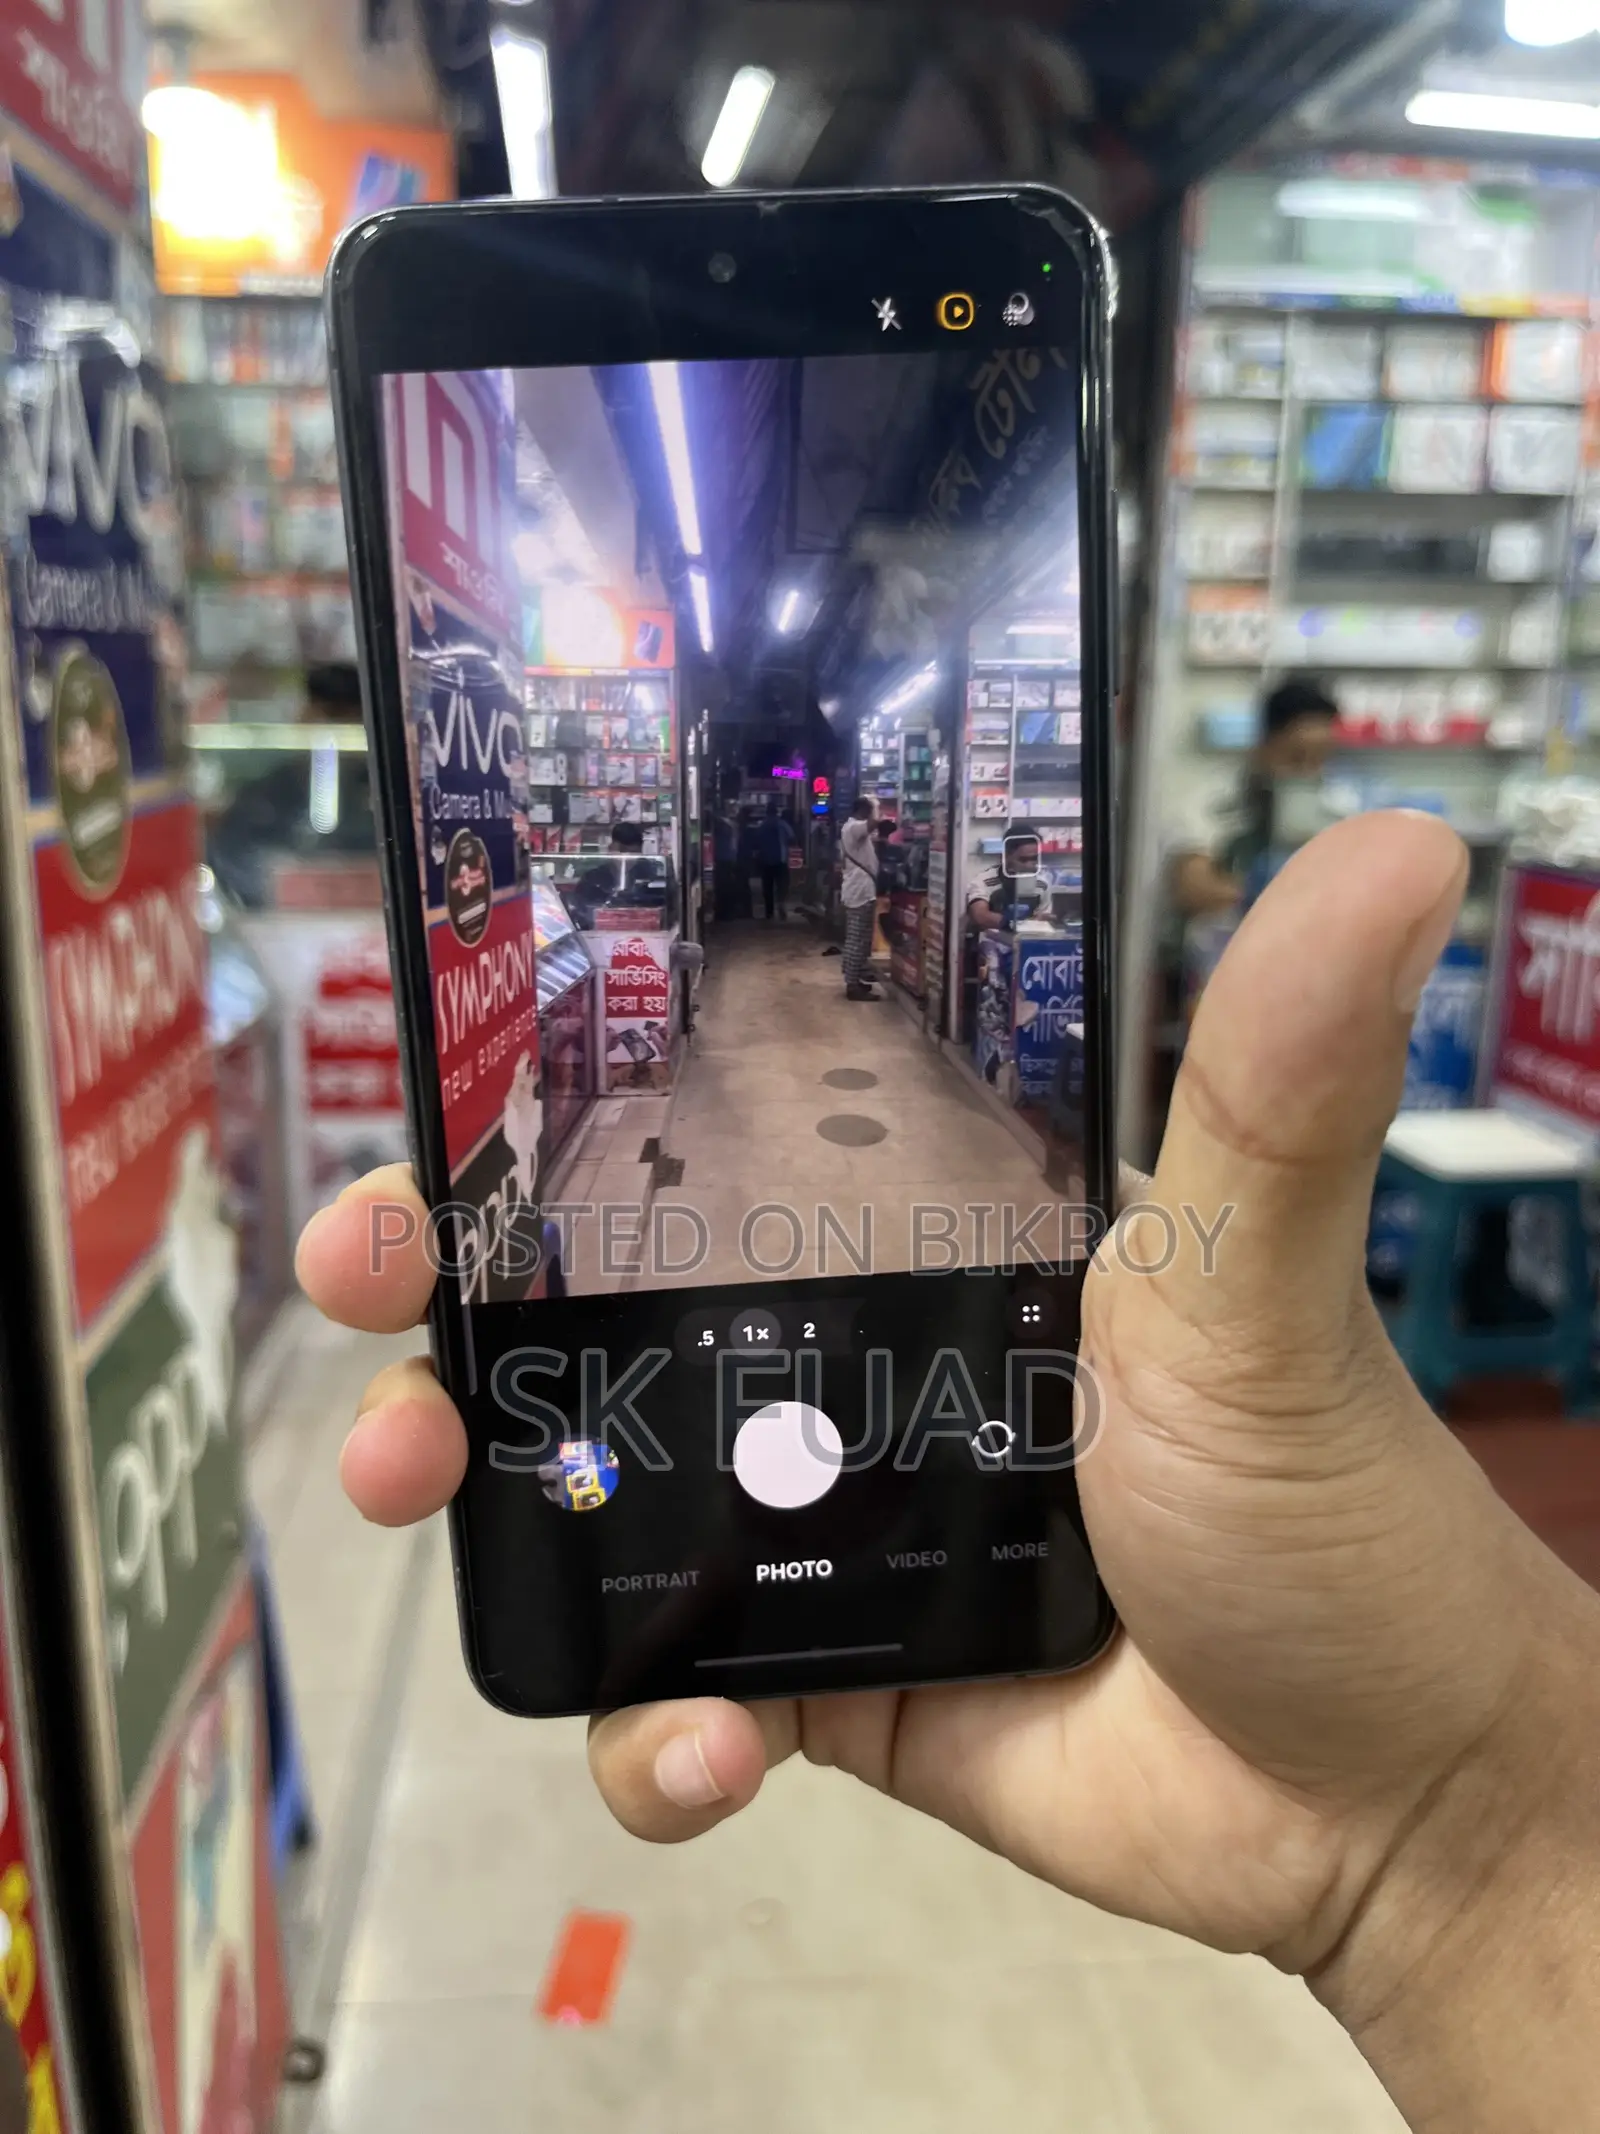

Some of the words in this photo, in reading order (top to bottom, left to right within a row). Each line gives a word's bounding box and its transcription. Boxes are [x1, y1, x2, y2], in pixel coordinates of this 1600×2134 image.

[429, 782, 480, 820] Camera
[437, 929, 533, 1055] SYMPHONY
[608, 996, 638, 1012] করা
[442, 1057, 472, 1110] new
[803, 1322, 816, 1339] 2
[886, 1549, 948, 1570] VIDEO
[991, 1541, 1050, 1562] MORE
[601, 1568, 701, 1594] PORTRAIT
[755, 1558, 834, 1583] PHOTO
